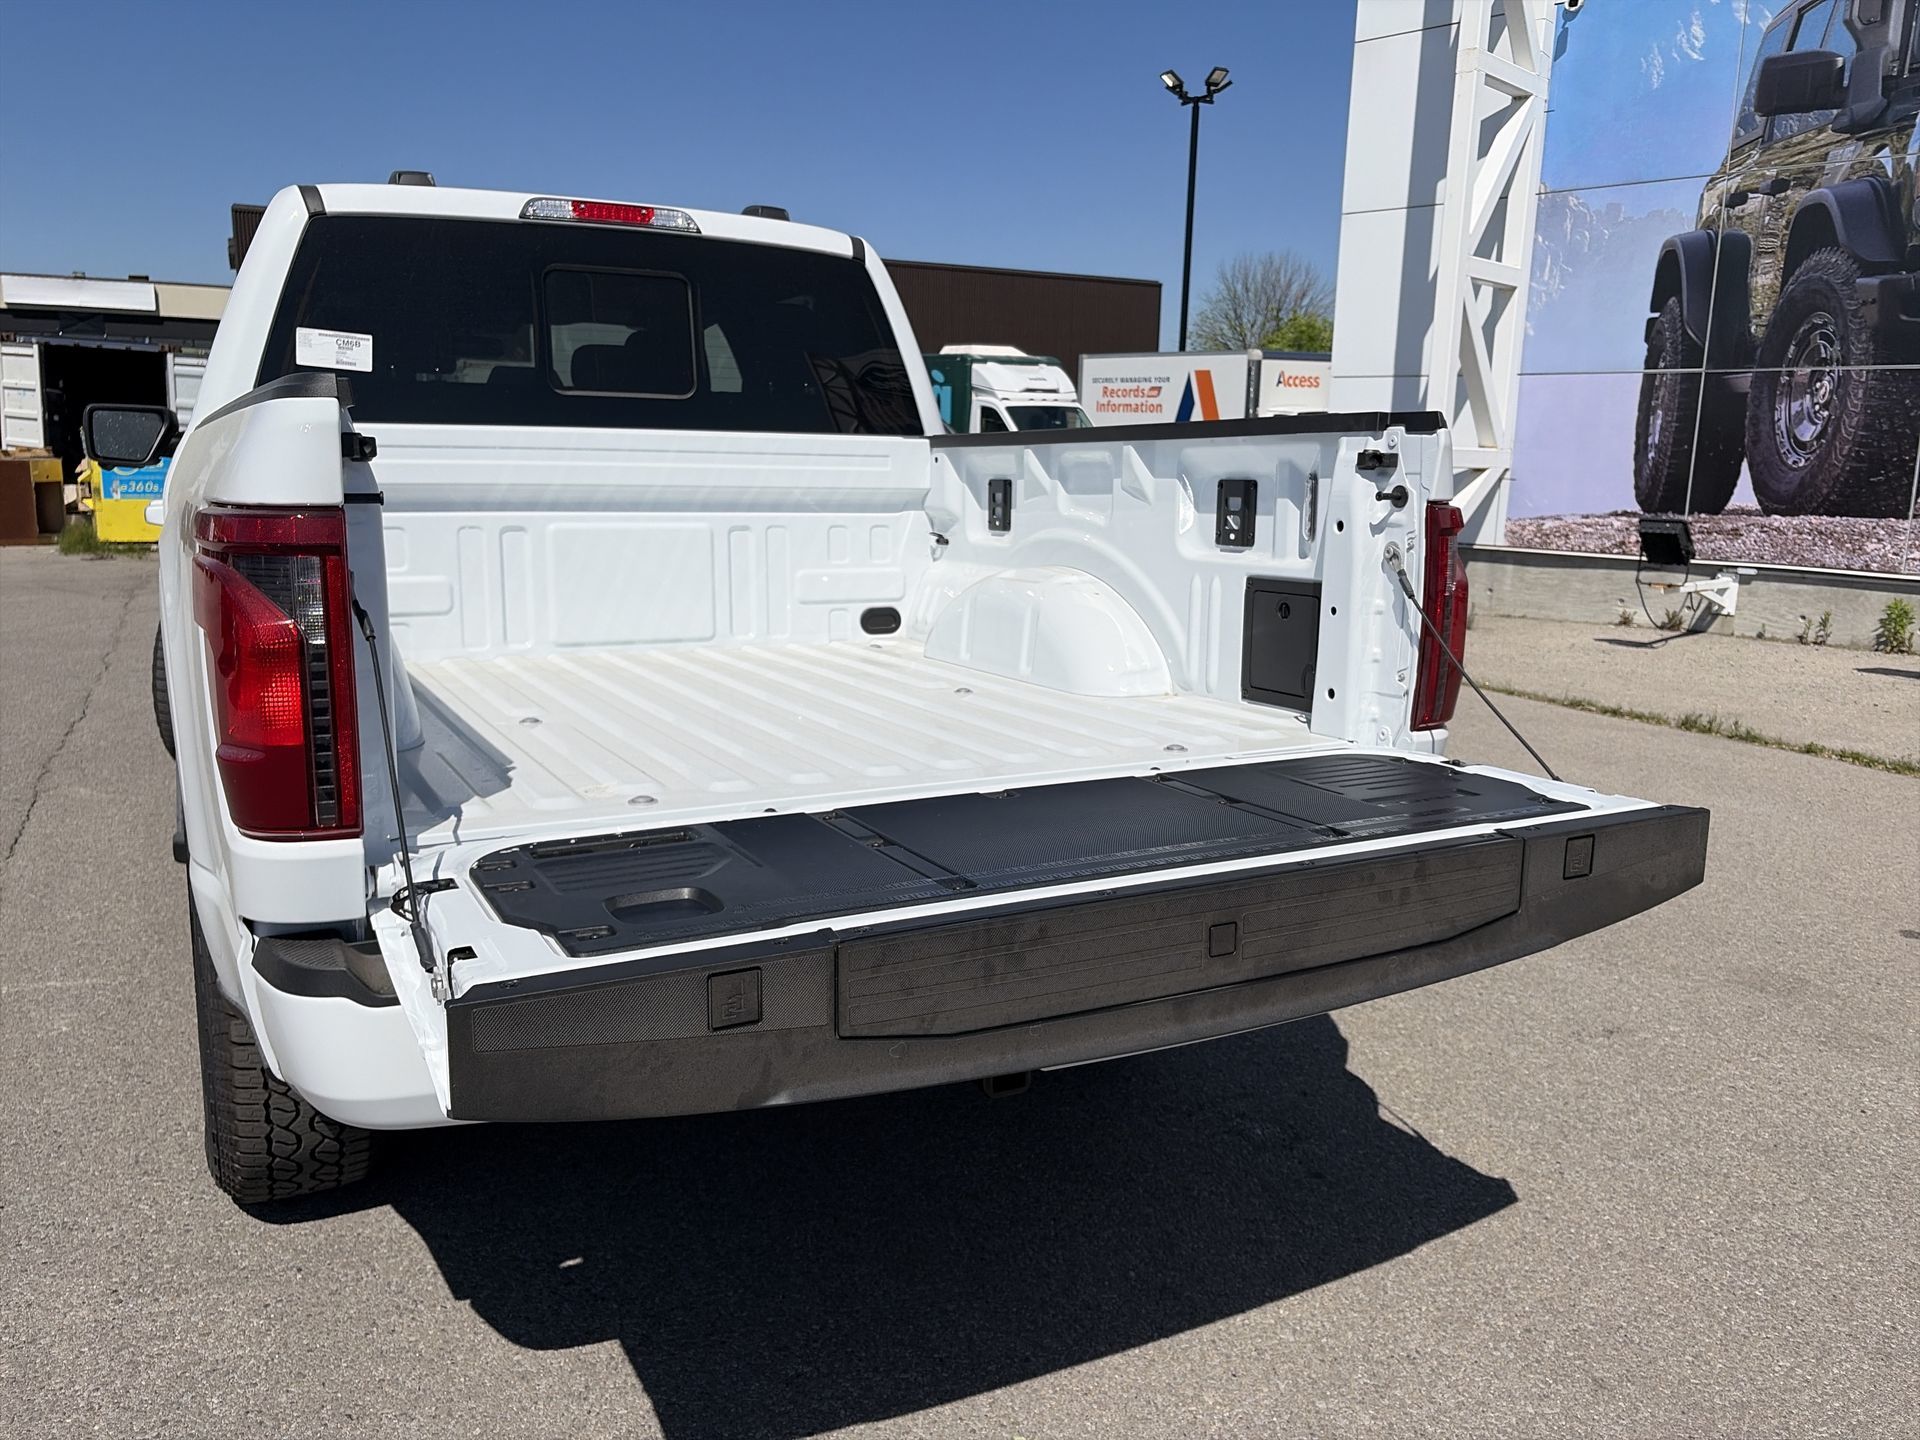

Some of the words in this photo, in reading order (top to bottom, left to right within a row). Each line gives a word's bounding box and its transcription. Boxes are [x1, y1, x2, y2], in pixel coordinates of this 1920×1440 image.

[1092, 376, 1119, 384] SECURELY
[1120, 376, 1152, 384] MANAGING
[1276, 370, 1320, 388] Access
[1102, 385, 1145, 398] Records
[1096, 400, 1163, 413] Information
